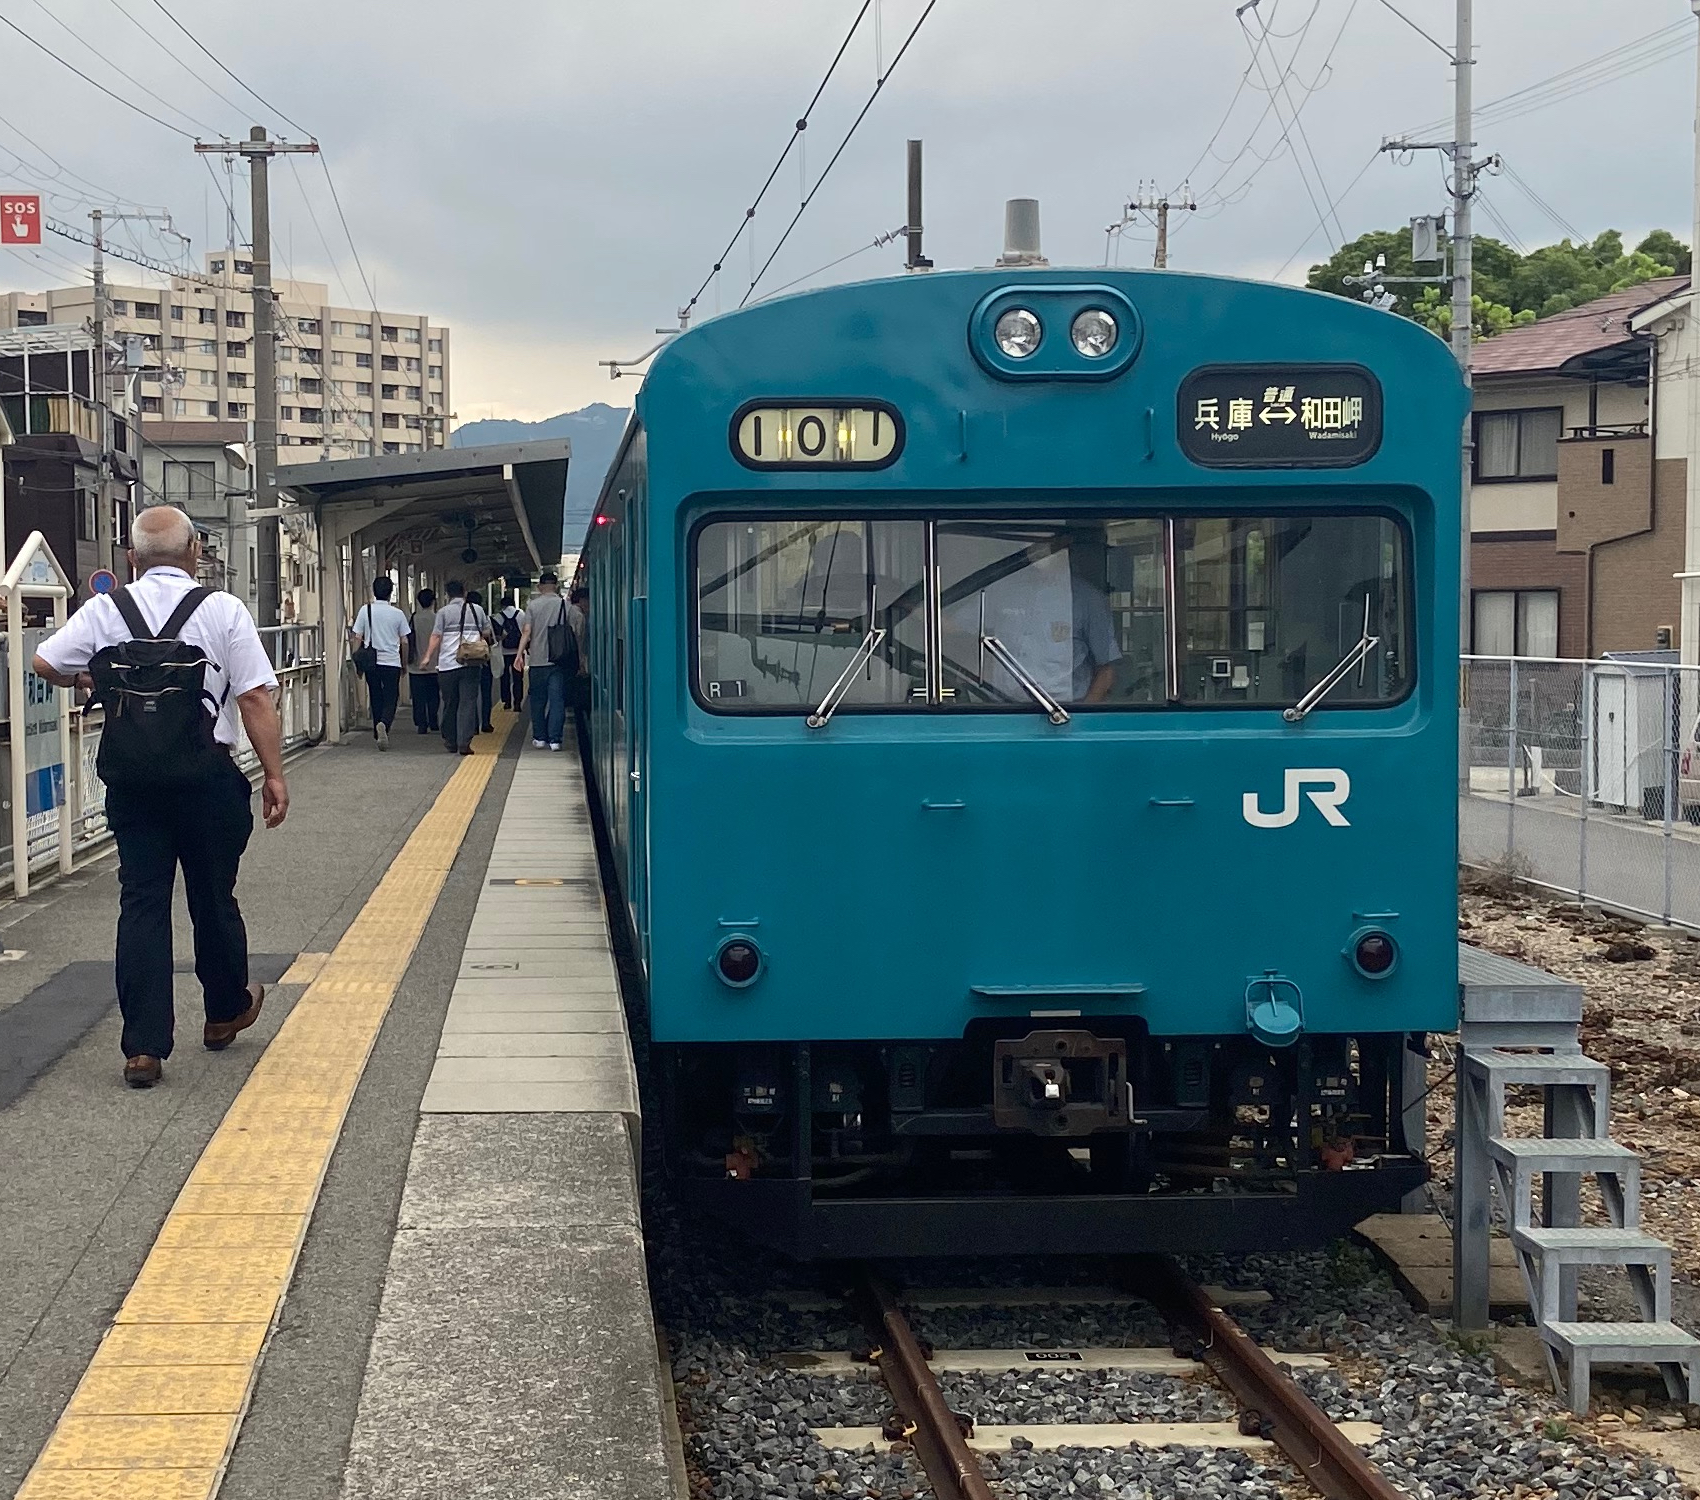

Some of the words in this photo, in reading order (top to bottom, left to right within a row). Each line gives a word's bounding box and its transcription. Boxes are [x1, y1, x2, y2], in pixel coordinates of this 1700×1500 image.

[4, 202, 36, 214] SOS
[1263, 386, 1296, 403] 普通
[1195, 398, 1254, 431] 兵庫
[1301, 396, 1363, 430] 和田岬
[1309, 431, 1357, 440] Wadamisaki
[709, 682, 720, 698] R
[735, 681, 742, 697] 1
[1243, 768, 1352, 828] JR
